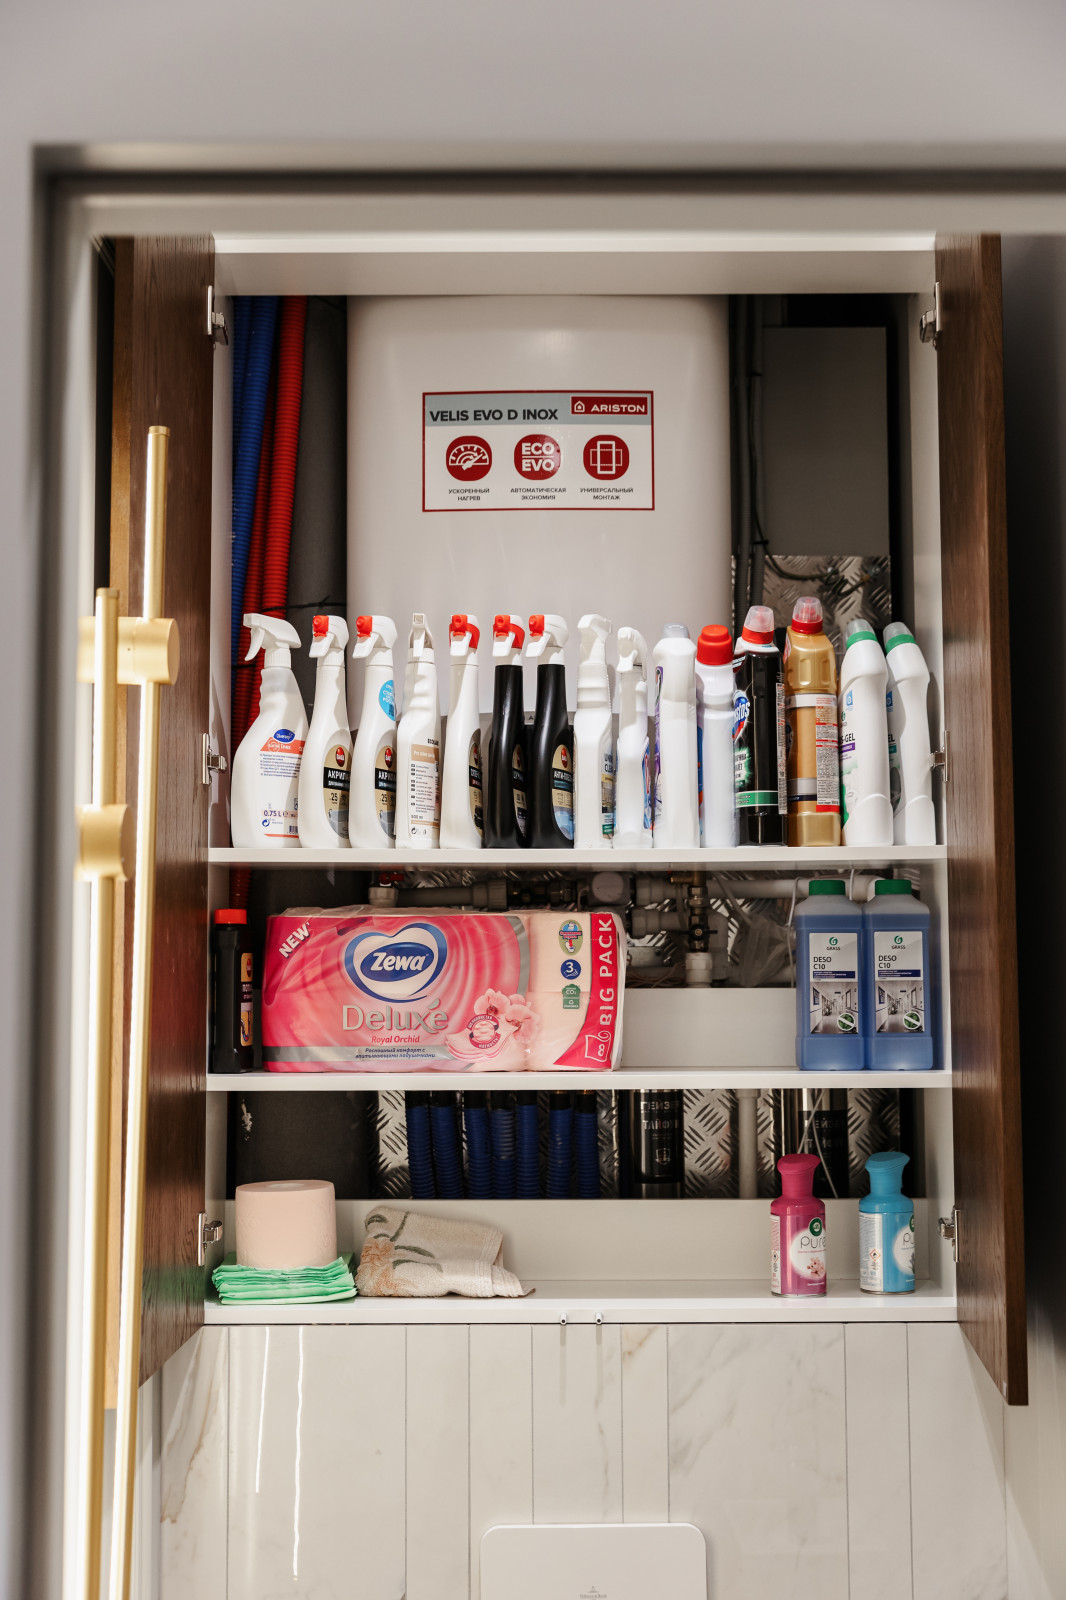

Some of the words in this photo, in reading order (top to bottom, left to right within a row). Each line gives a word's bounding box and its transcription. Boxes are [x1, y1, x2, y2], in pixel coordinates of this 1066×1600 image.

[591, 404, 645, 413] ARISTON
[430, 410, 468, 422] VELIS
[474, 410, 503, 421] EVO
[508, 410, 518, 420] D
[523, 409, 558, 420] INOX
[521, 442, 554, 455] ECO
[522, 459, 555, 471] EVO
[331, 793, 338, 801] 25
[598, 919, 613, 977] PACK
[371, 952, 426, 971] Zewa
[566, 963, 574, 973] 3
[600, 988, 614, 1025] BIG
[372, 1036, 392, 1045] Royal
